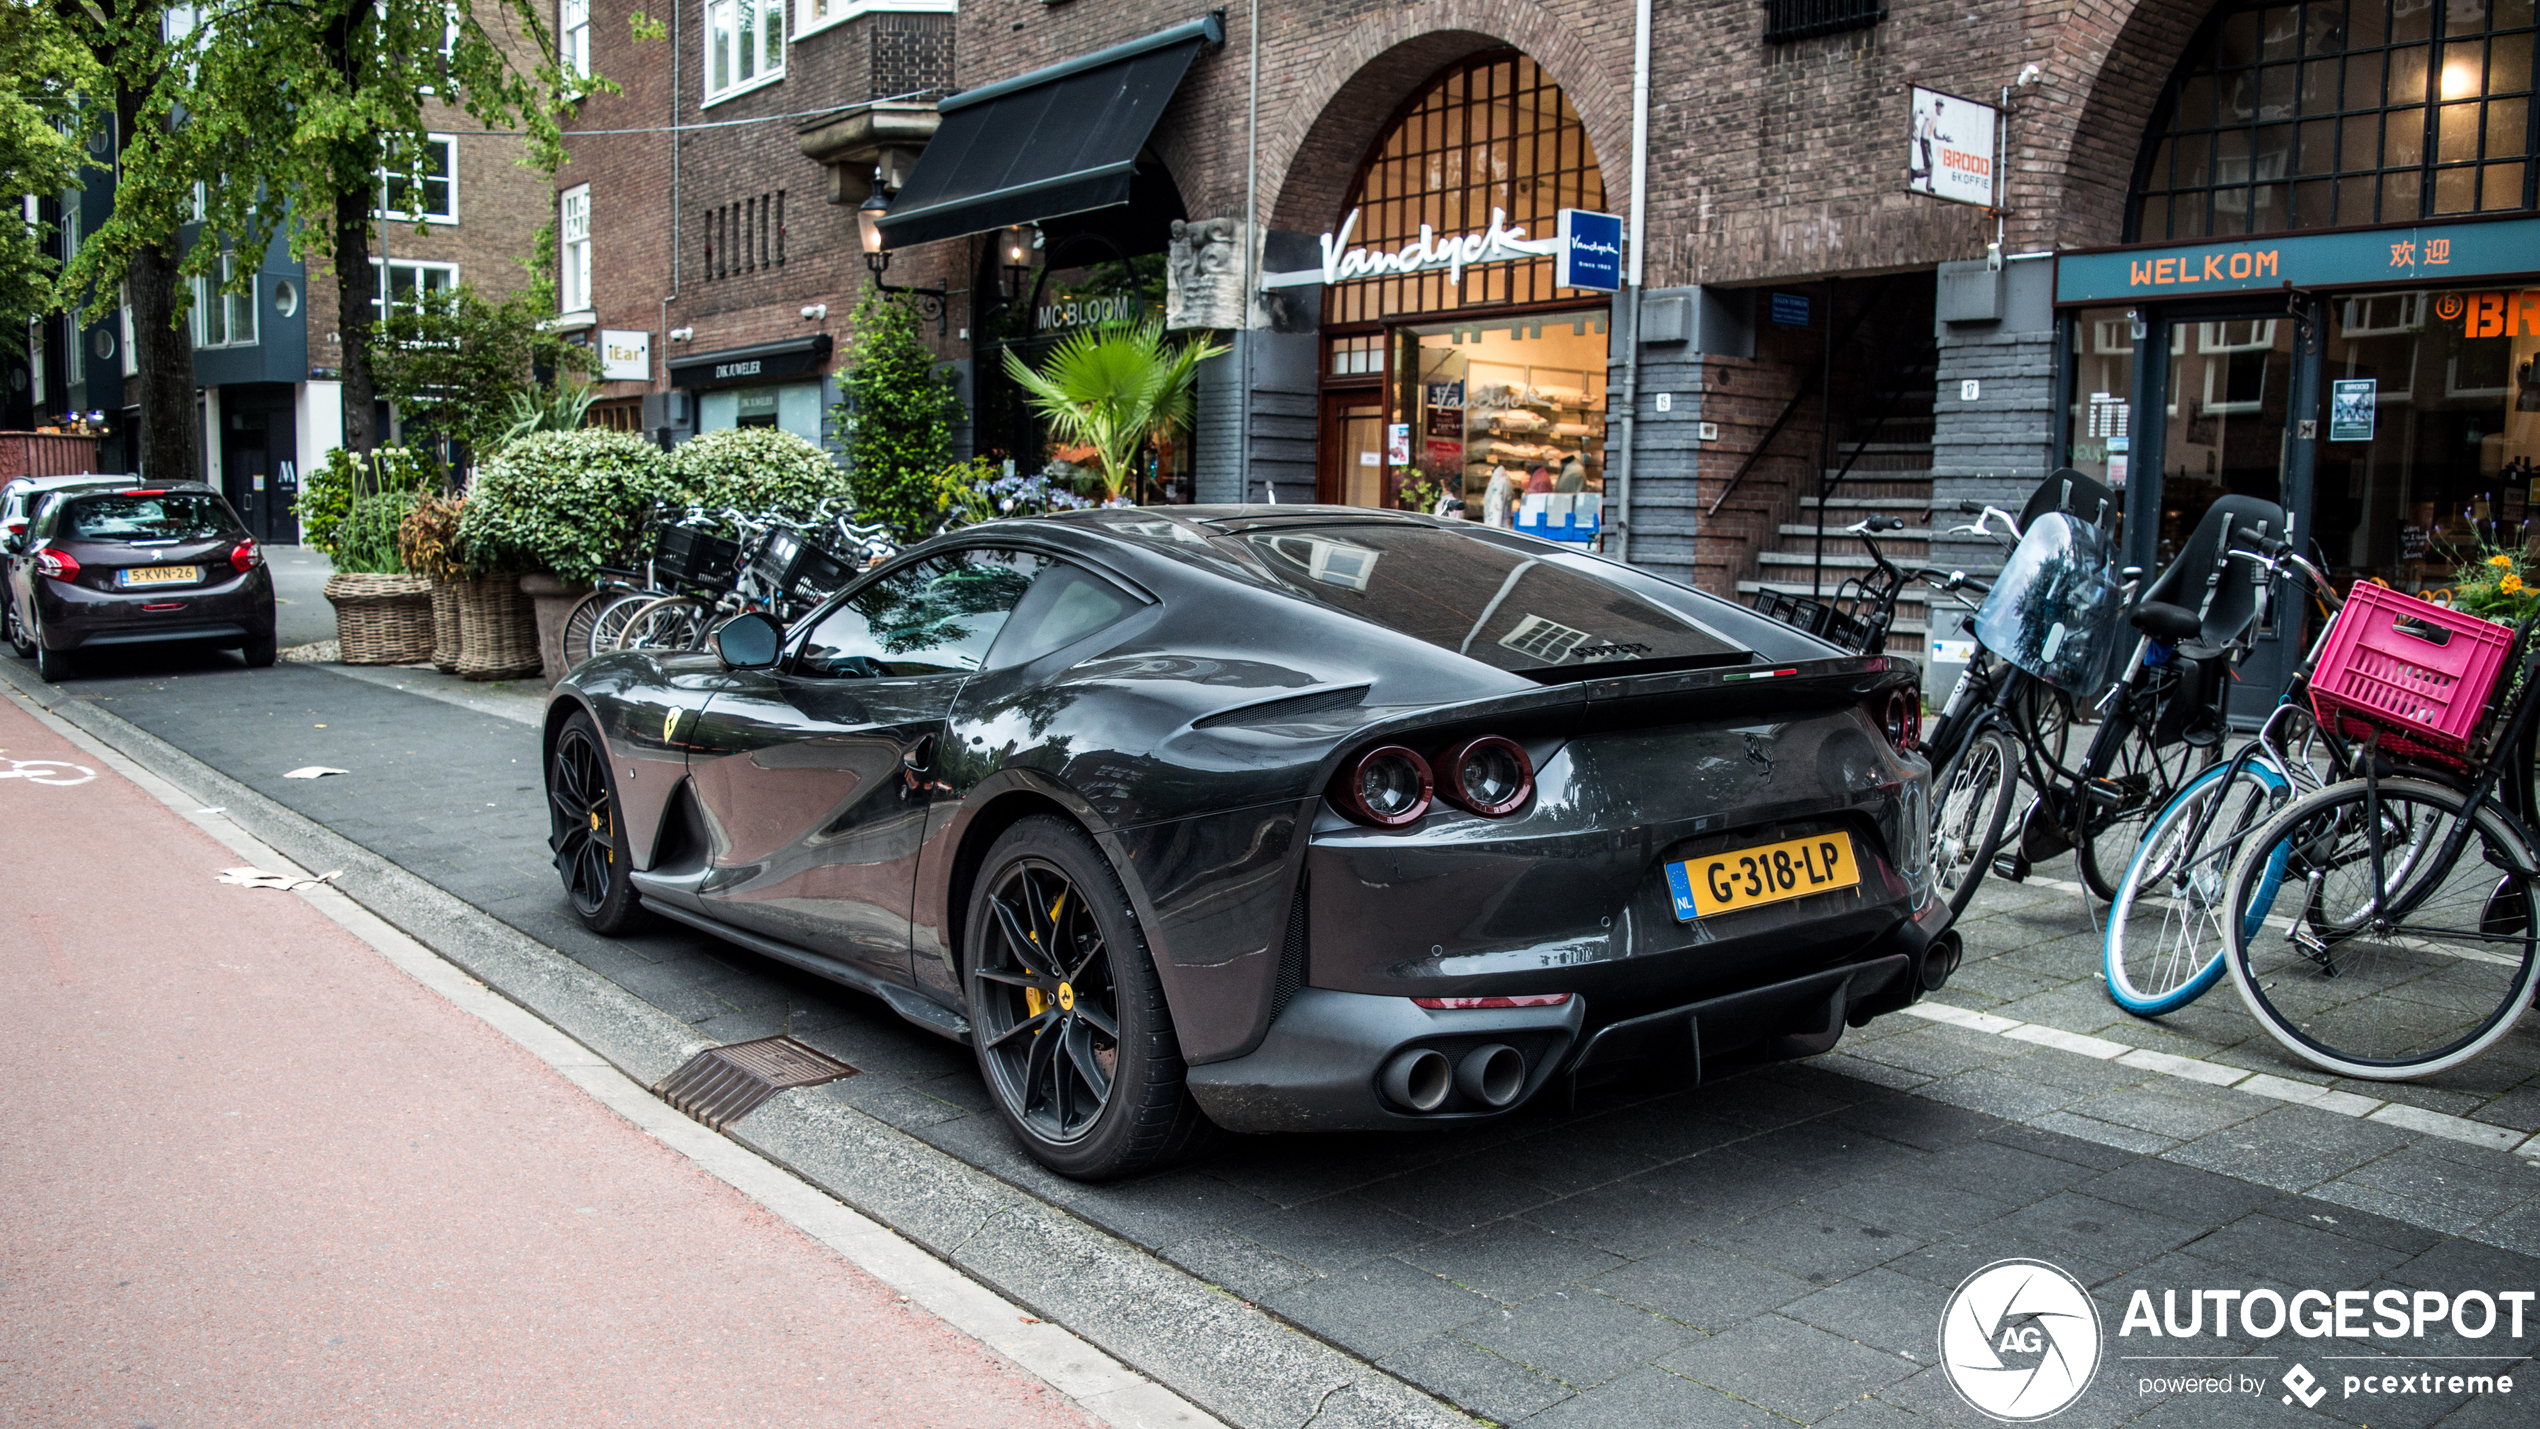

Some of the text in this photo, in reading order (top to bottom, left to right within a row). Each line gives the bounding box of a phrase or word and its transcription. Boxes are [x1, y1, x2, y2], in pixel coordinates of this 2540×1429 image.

[1943, 148, 1989, 176] BROOD
[1952, 171, 1989, 189] &KOFFIE
[1320, 207, 1548, 286] Vandyck
[1571, 234, 1619, 256] Vandyck
[2390, 239, 2450, 268] 欢迎
[2131, 250, 2278, 286] WELKOM
[1039, 295, 1128, 329] MC BLOOM
[1435, 378, 1552, 417] Vandyck
[1660, 396, 1667, 409] 15
[1967, 383, 1975, 398] 17
[132, 568, 193, 581] 5-KVN-26
[1707, 842, 1839, 904] G-318-LP
[1677, 896, 1693, 911] NL
